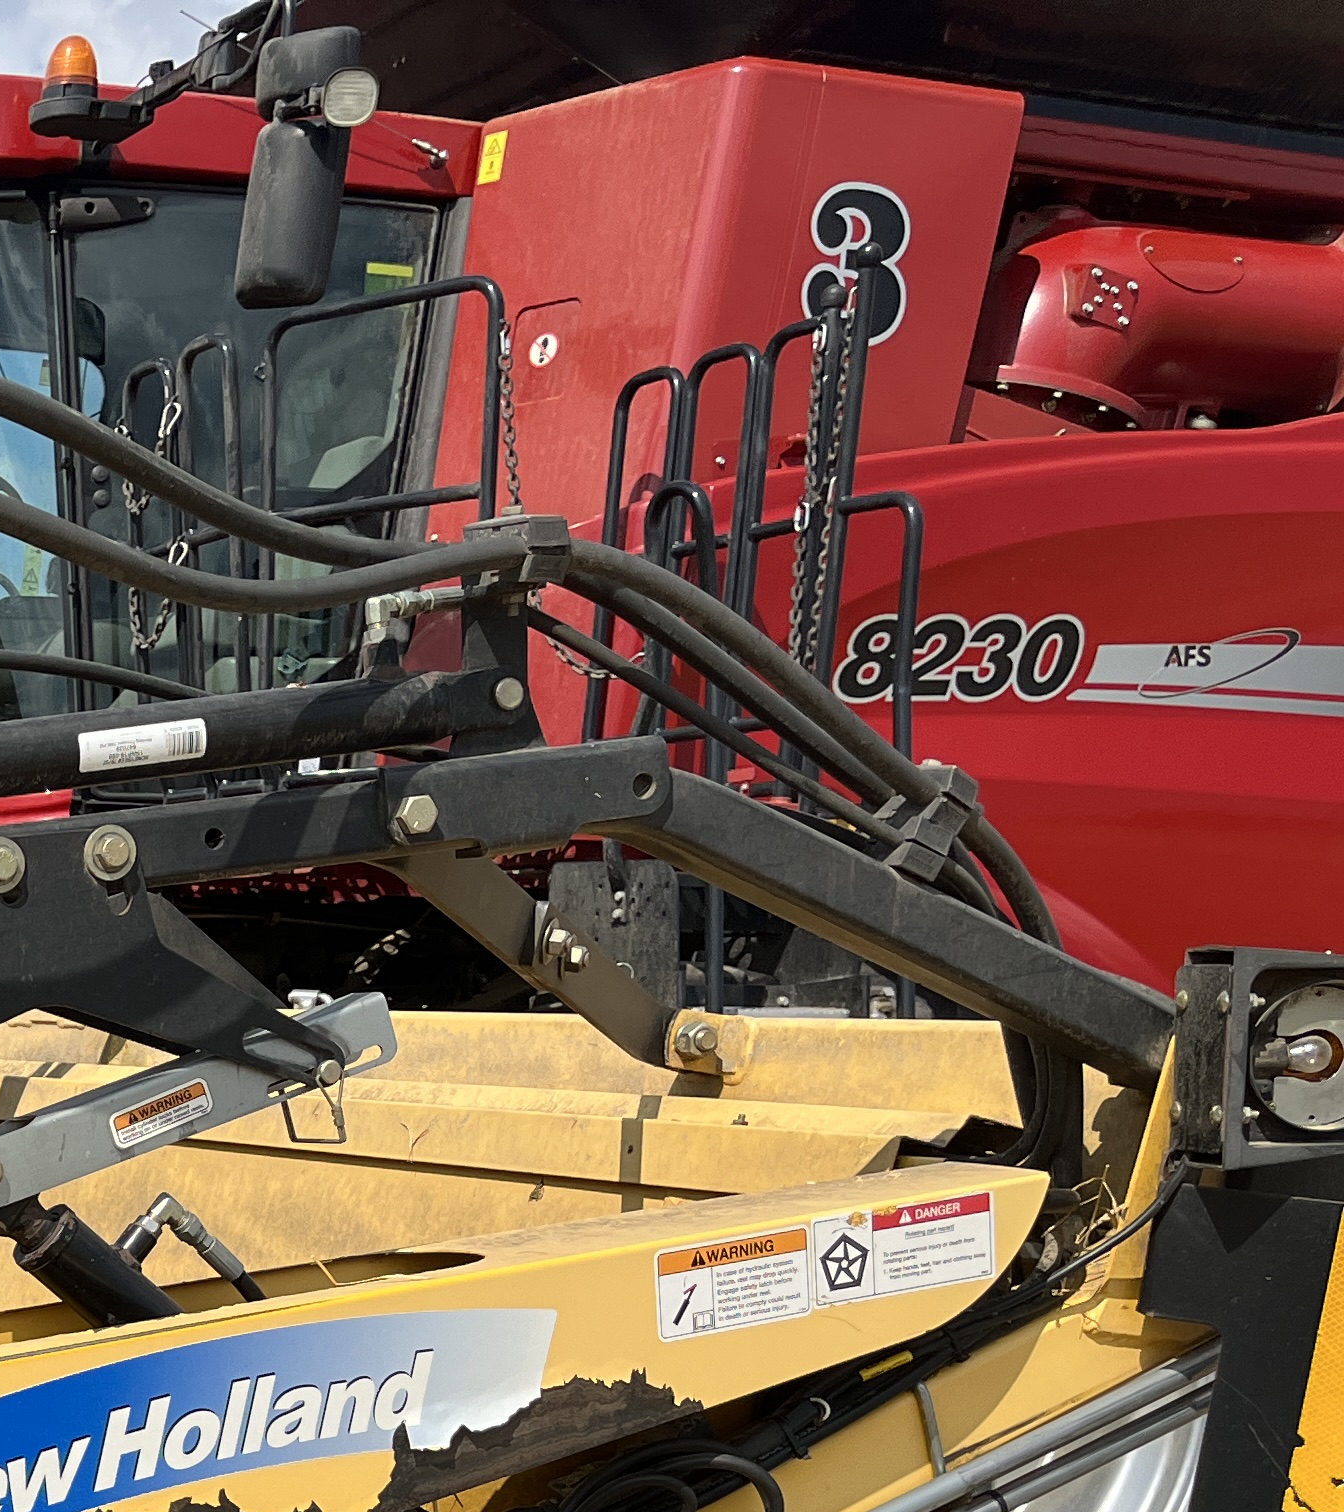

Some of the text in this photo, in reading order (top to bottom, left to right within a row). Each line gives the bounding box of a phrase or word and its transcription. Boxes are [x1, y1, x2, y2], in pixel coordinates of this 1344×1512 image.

[801, 181, 911, 348] 3
[831, 612, 1085, 704] 8230
[1164, 644, 1212, 667] AFS
[138, 1088, 193, 1120] WARNING
[914, 1201, 962, 1220] DANGER
[706, 1239, 775, 1263] WARNING
[94, 1349, 434, 1491] Holland
